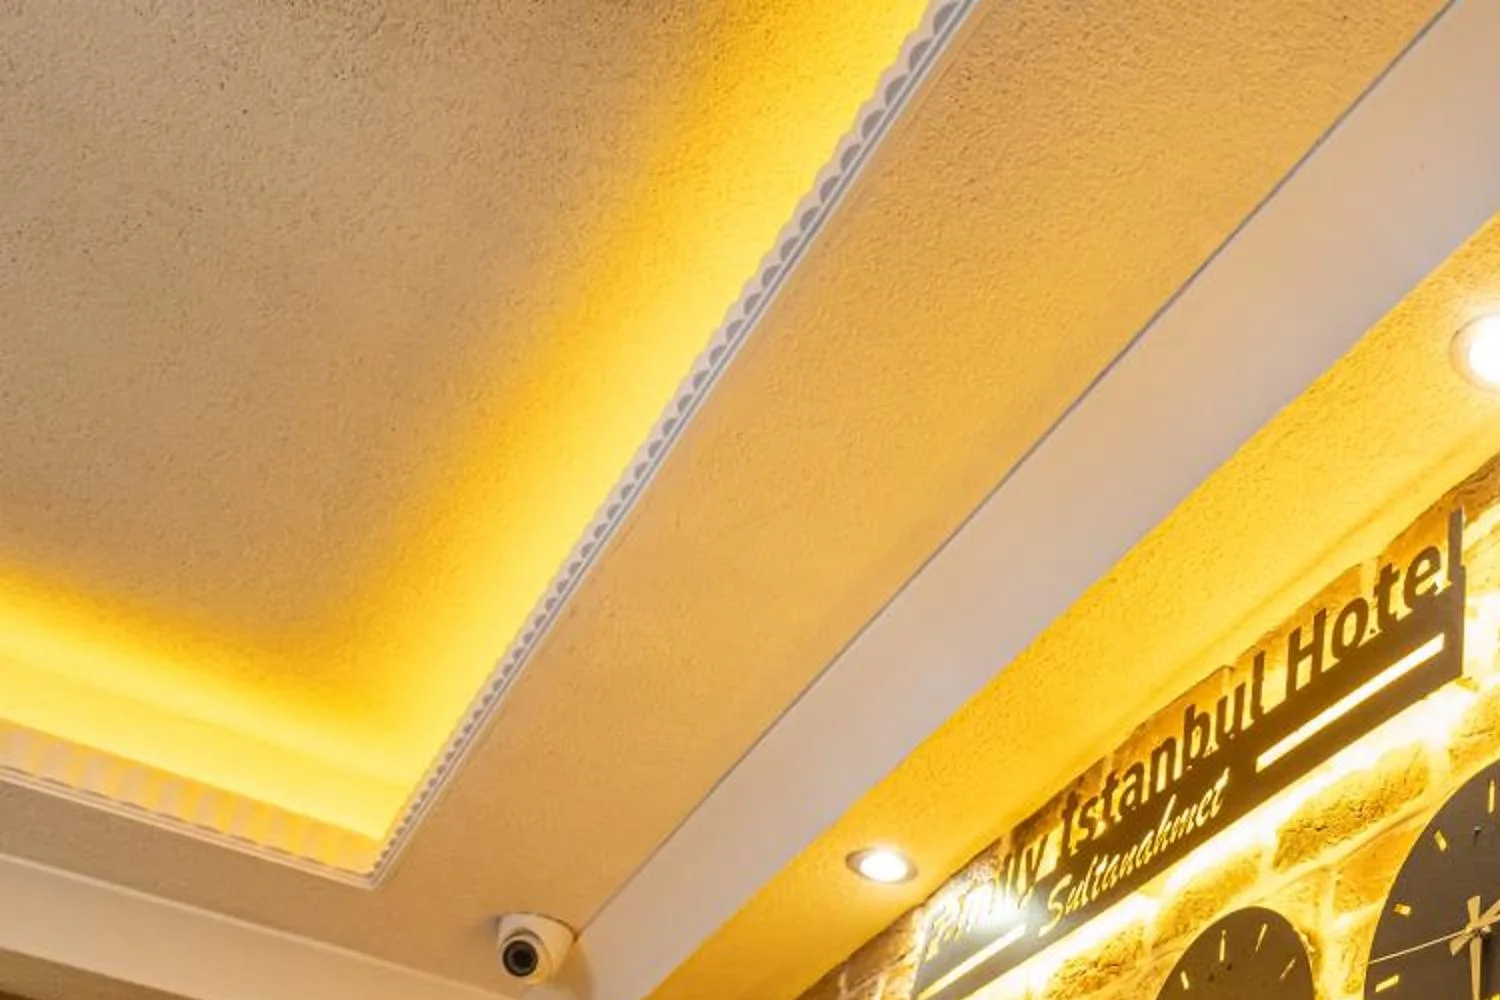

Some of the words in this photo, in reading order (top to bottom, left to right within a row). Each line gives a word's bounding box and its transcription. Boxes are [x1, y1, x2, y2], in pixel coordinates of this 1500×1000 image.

[1060, 650, 1265, 858] Istanbul
[1286, 507, 1464, 702] Hotel
[1037, 766, 1231, 937] Sultanahmet
